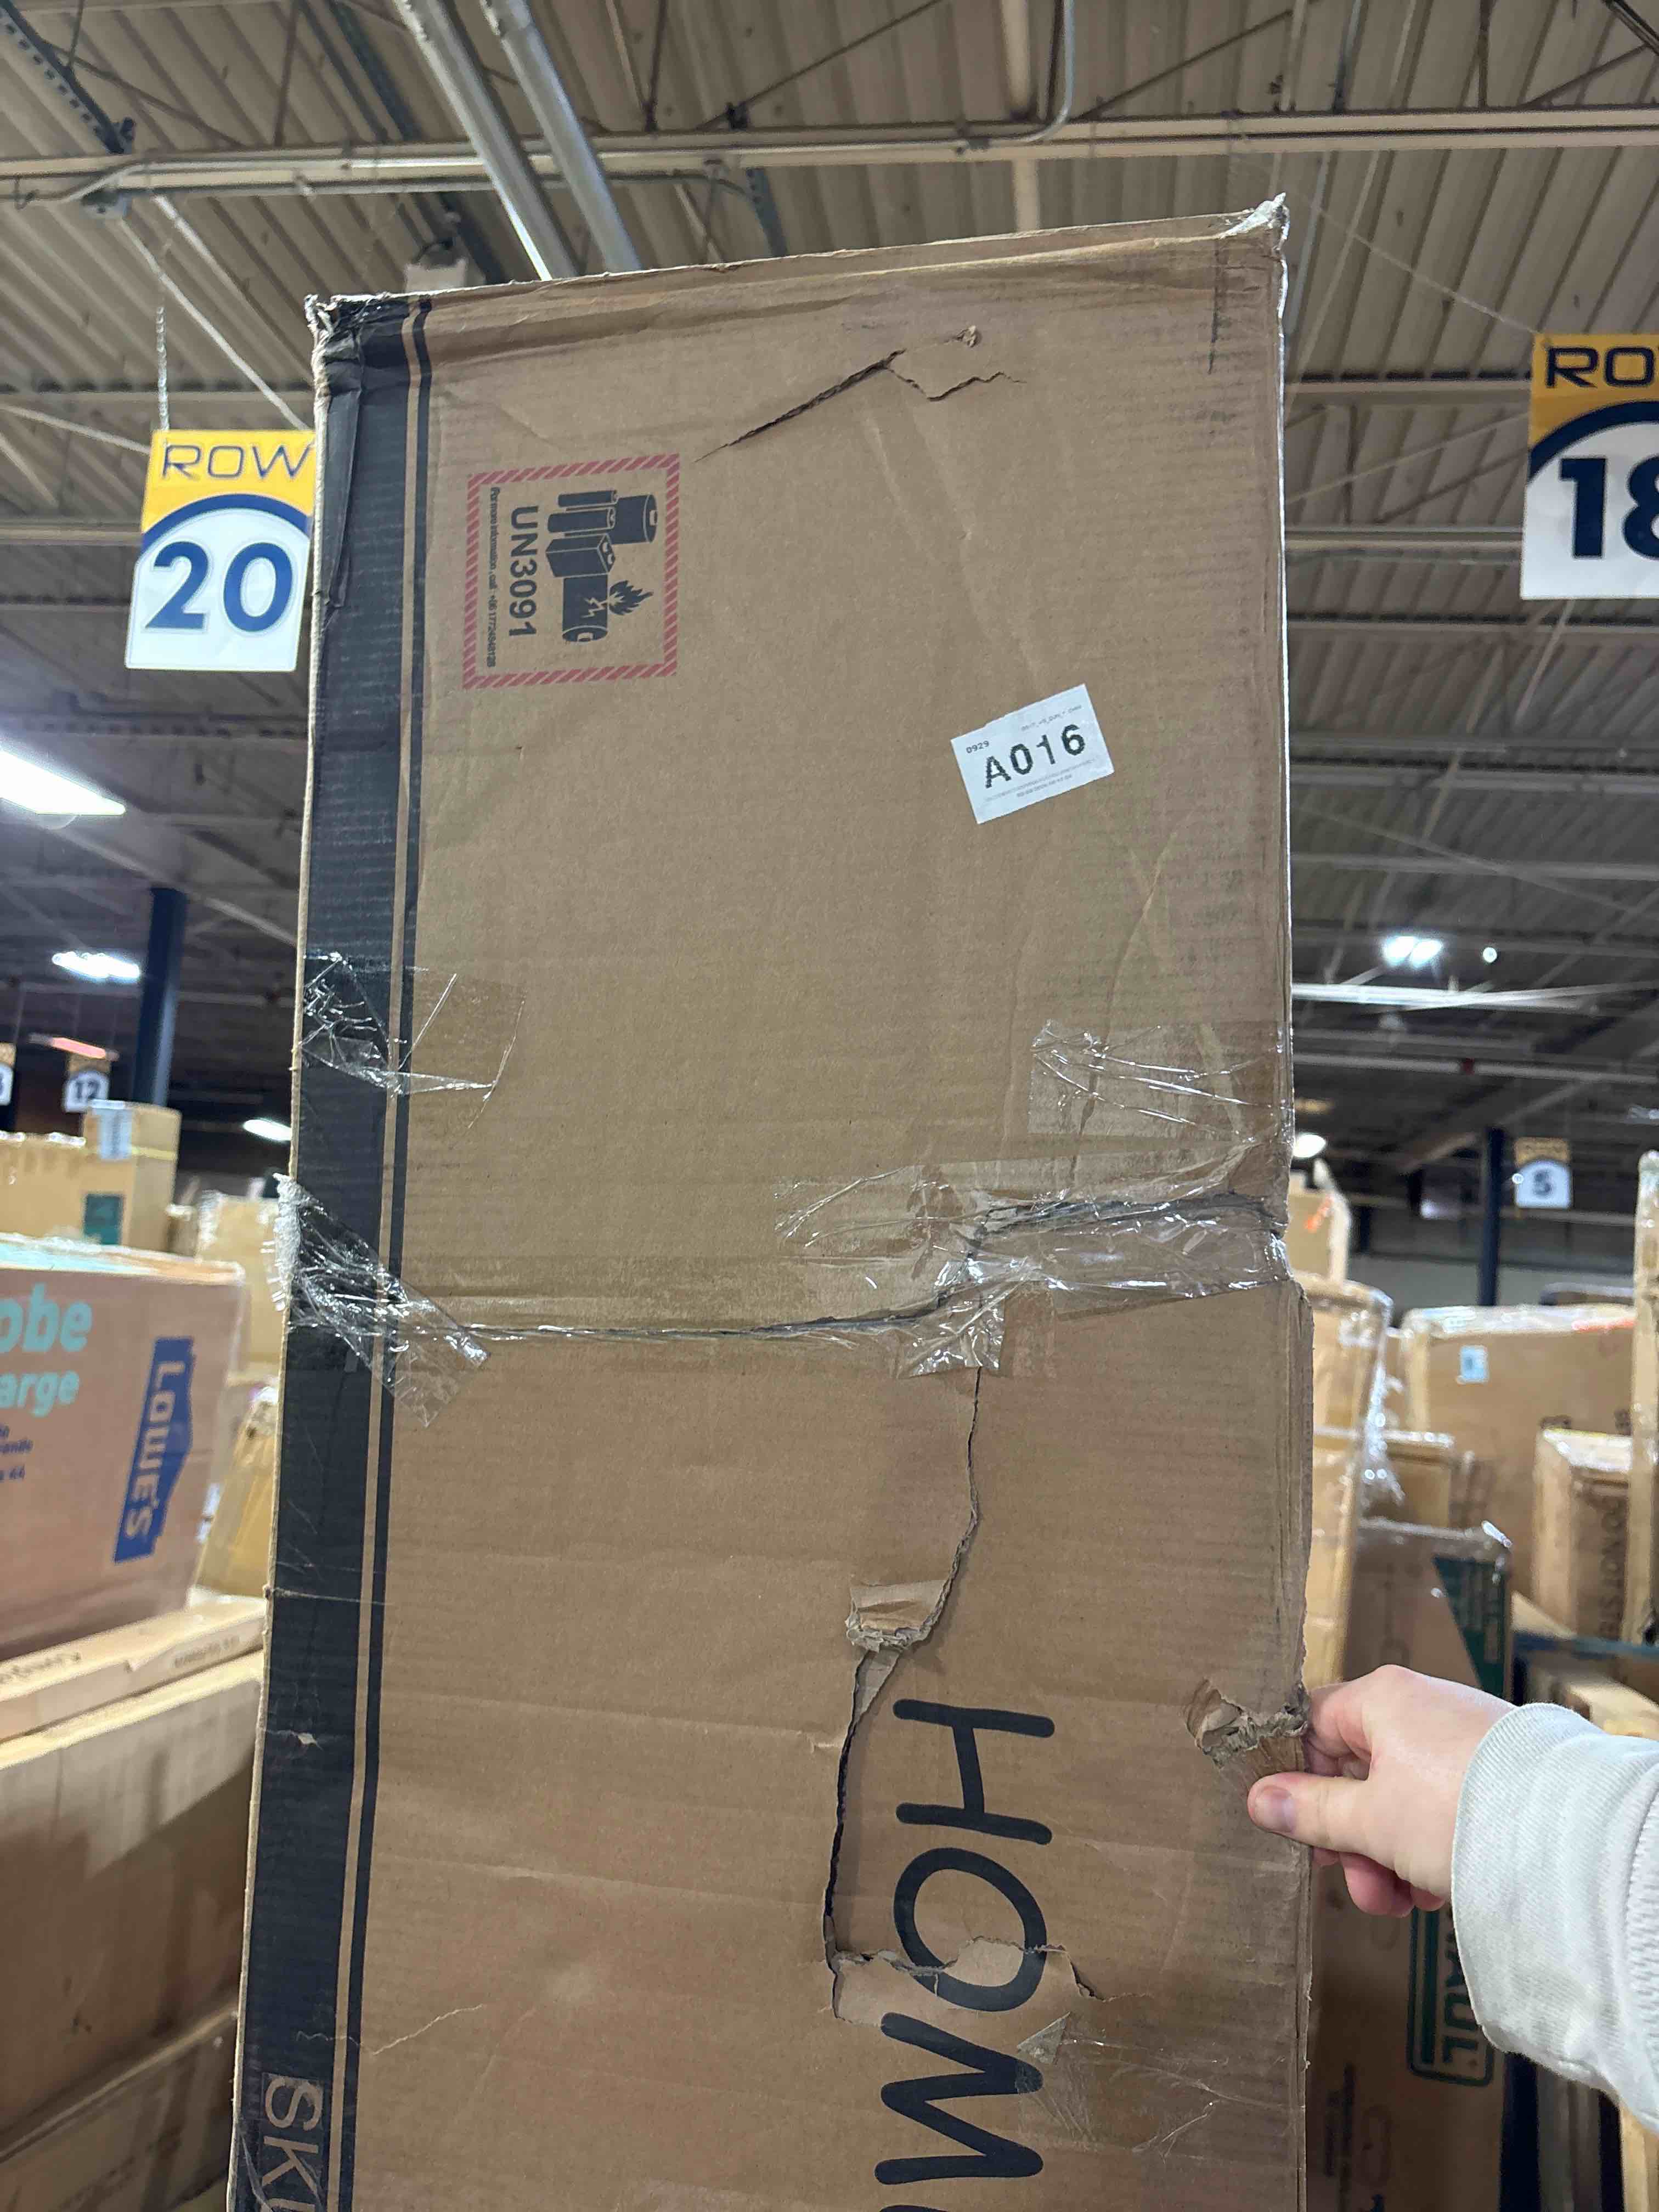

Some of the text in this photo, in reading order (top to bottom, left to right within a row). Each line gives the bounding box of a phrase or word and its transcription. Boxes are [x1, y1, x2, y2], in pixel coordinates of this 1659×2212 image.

[1545, 345, 1659, 388] RO
[162, 444, 309, 480] ROW
[145, 540, 294, 633] 20
[509, 505, 539, 636] UN3091
[966, 740, 990, 754] 0929
[985, 724, 1086, 788] A016
[874, 1699, 1055, 2212] HOM
[261, 2076, 323, 2212] SK
